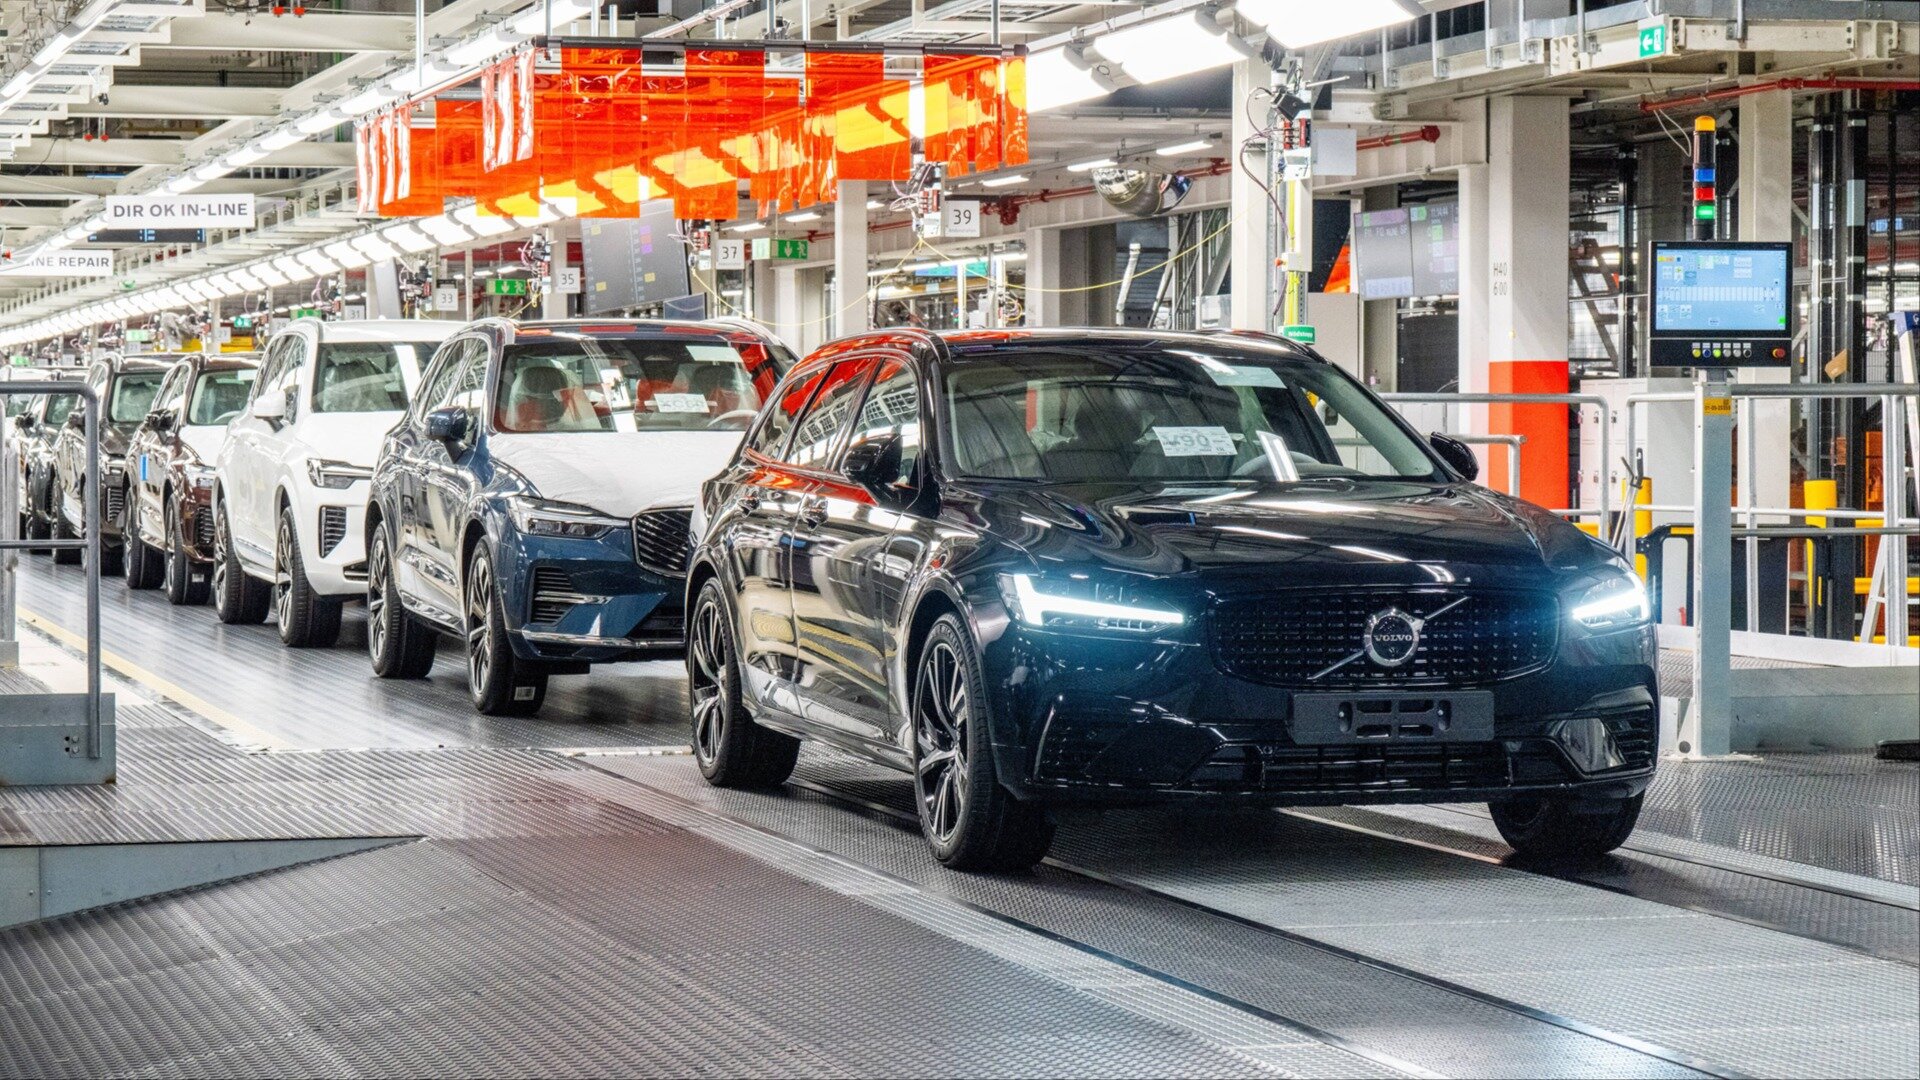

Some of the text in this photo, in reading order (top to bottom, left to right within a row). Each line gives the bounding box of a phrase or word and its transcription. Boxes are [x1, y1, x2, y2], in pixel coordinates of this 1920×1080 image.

[113, 202, 248, 218] DIR OK IN-LINE
[953, 209, 972, 225] 39
[721, 246, 738, 260] 37
[25, 256, 110, 267] INE REPAIR
[560, 273, 575, 285] 35
[441, 293, 453, 303] 33
[1373, 634, 1413, 642] VOLVO
